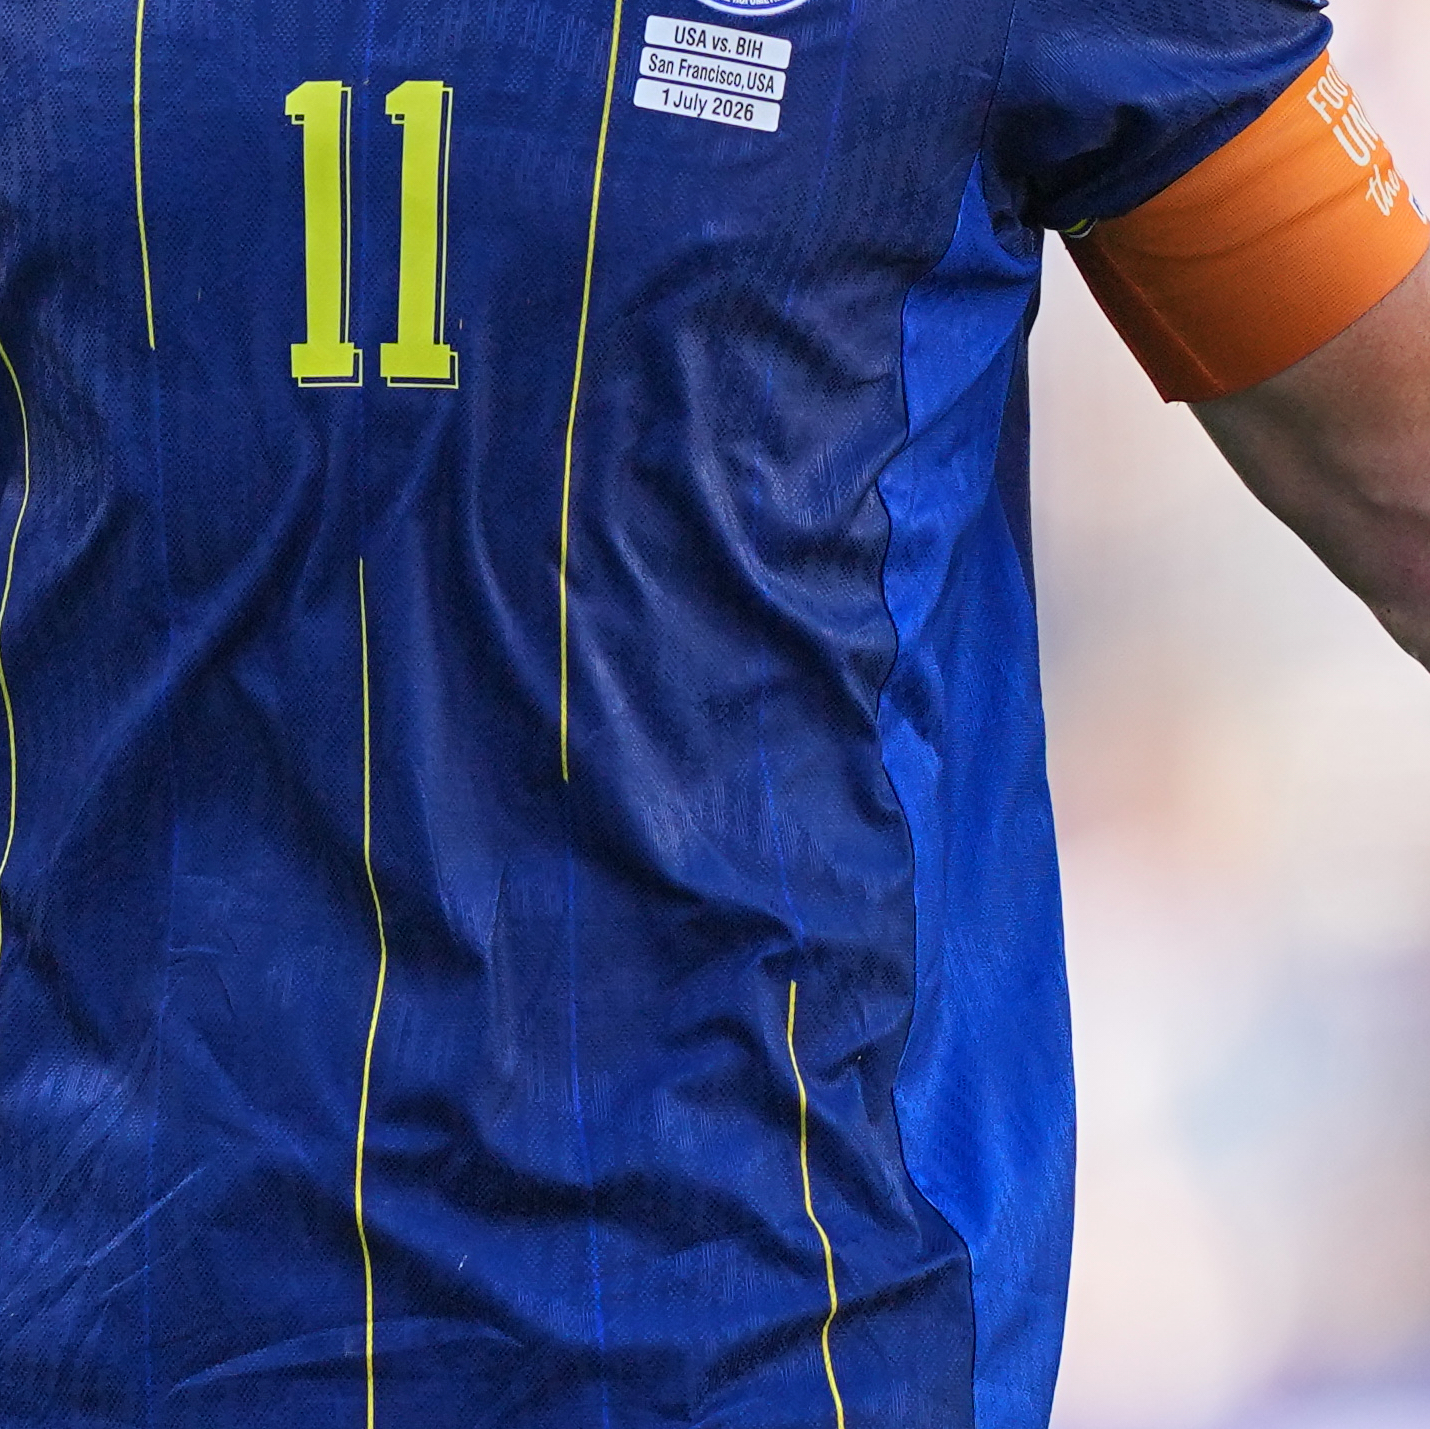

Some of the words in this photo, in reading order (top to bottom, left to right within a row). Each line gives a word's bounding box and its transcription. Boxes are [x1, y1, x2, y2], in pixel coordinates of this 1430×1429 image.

[674, 25, 707, 49] USA
[712, 35, 731, 54] vs.
[736, 37, 763, 59] BIH
[648, 53, 674, 75] San
[662, 88, 670, 105] 1
[673, 91, 708, 117] July
[712, 97, 755, 122] 2026
[284, 79, 459, 390] 11
